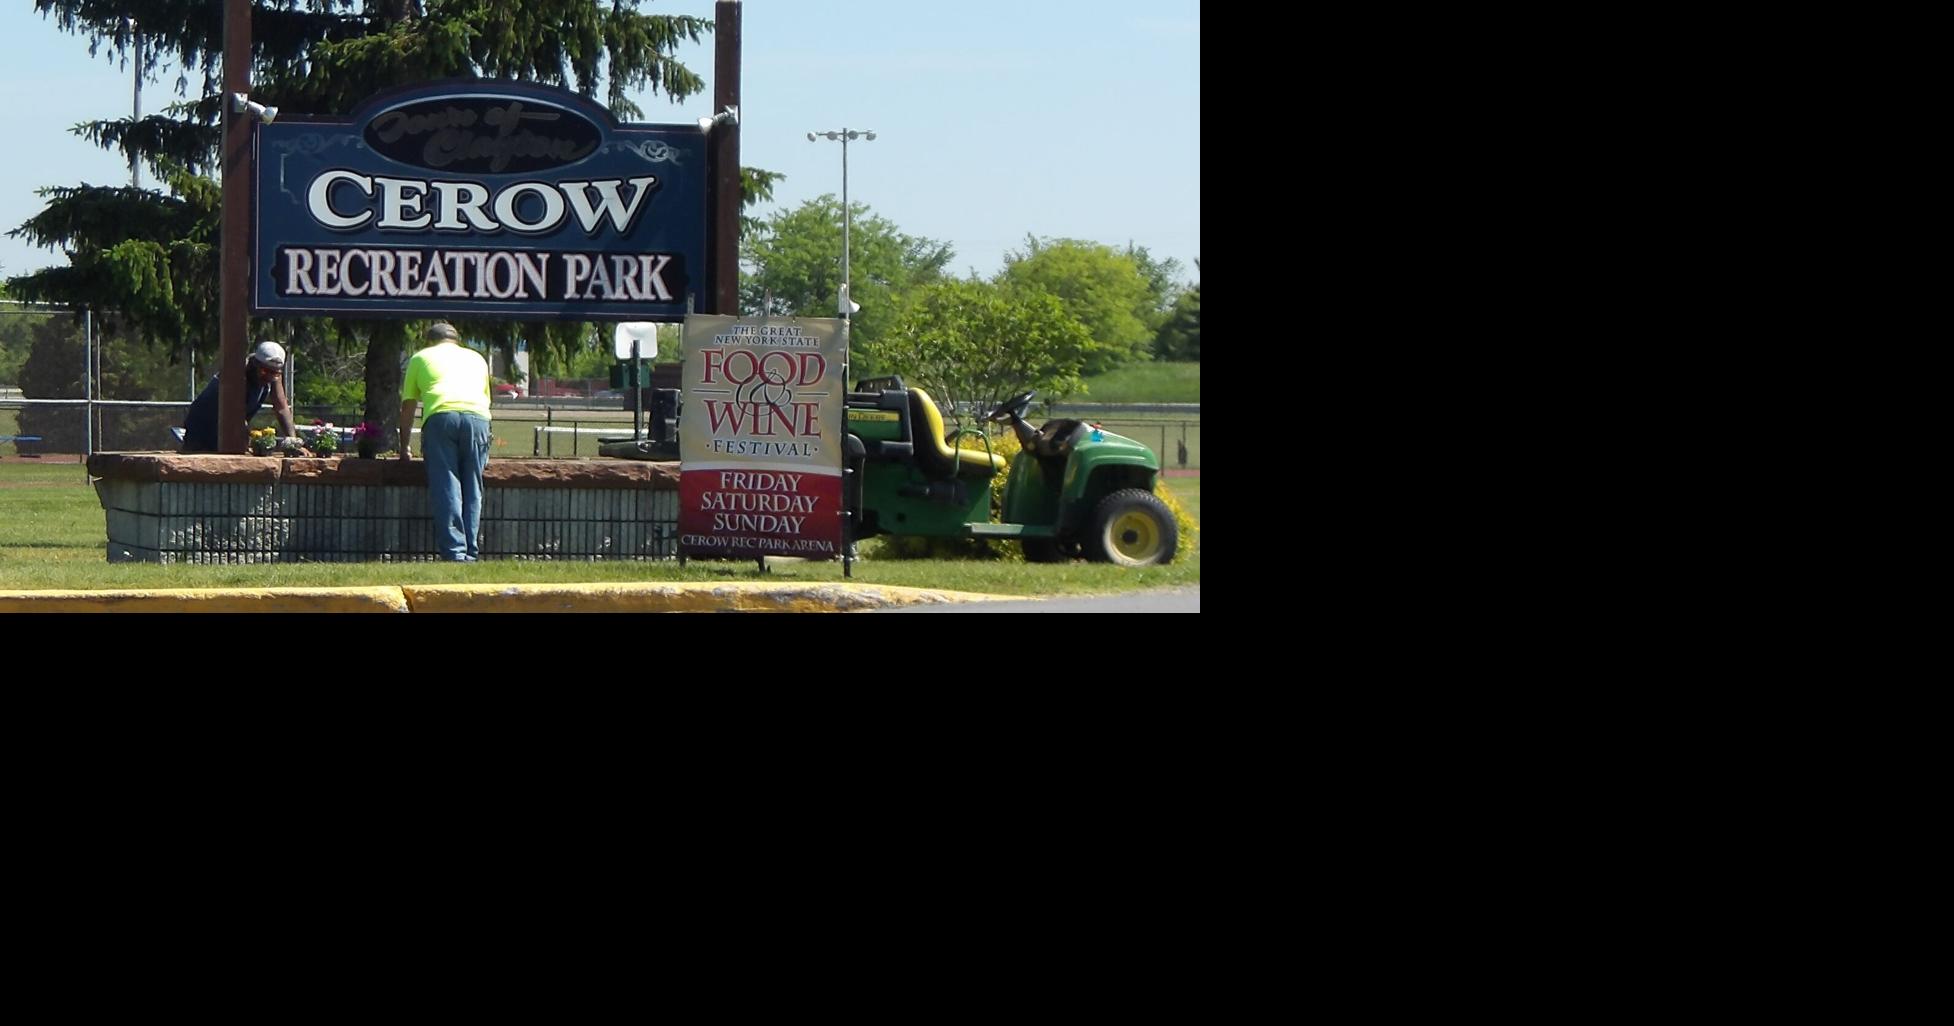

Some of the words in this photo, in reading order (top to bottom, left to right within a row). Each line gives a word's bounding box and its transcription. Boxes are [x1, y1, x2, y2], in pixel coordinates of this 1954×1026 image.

[308, 169, 655, 233] CEROW
[284, 248, 550, 298] RECREATION
[562, 253, 673, 300] PARK
[715, 335, 741, 345] NEW
[746, 335, 776, 345] YORK
[781, 336, 819, 347] STATE
[733, 326, 756, 336] THE
[760, 326, 802, 337] GREAT
[701, 348, 826, 387] FOOD
[704, 399, 822, 439] WINE
[721, 472, 803, 492] FRIDAY
[701, 492, 820, 514] SATURDAY
[713, 513, 806, 534] SUNDAY
[681, 534, 729, 546] CEROW
[731, 536, 757, 548] REC
[758, 538, 791, 550] PARK
[792, 539, 834, 552] ARENA
